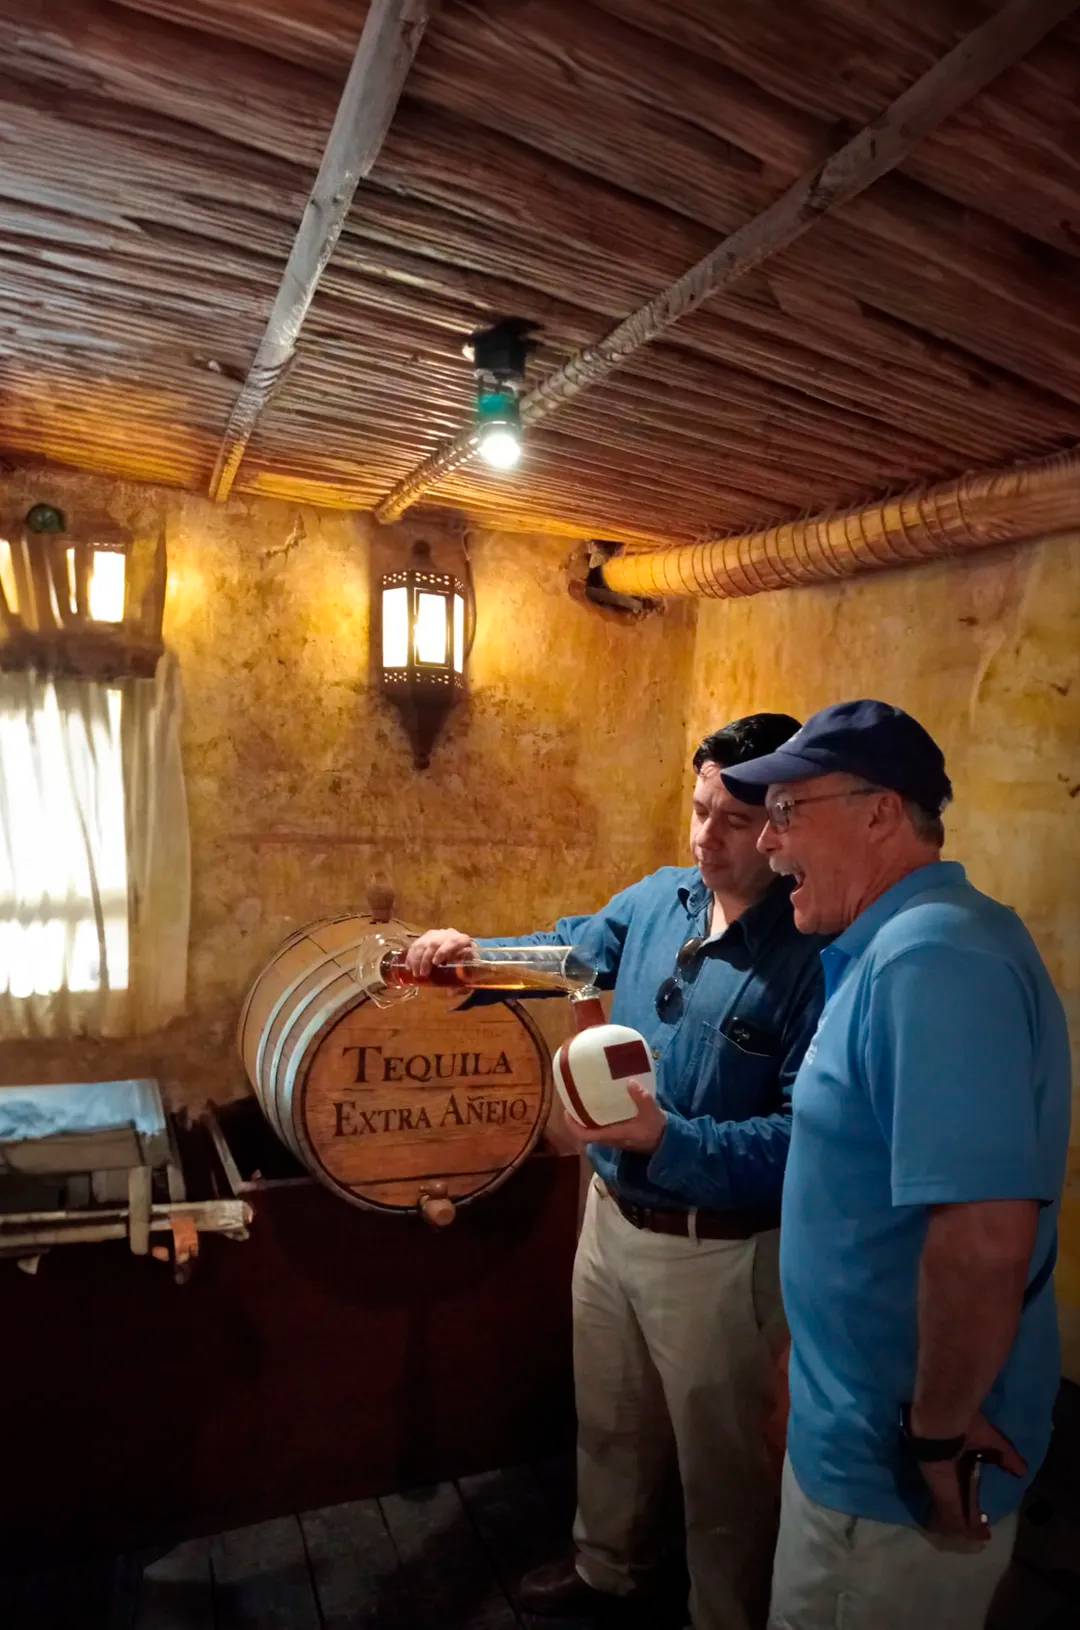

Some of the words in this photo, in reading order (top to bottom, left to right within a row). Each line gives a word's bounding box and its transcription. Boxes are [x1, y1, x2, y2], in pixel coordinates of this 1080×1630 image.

[342, 1046, 513, 1083] TEQUILA
[333, 1101, 432, 1137] EXTRA
[439, 1092, 528, 1126] AÑEJO
